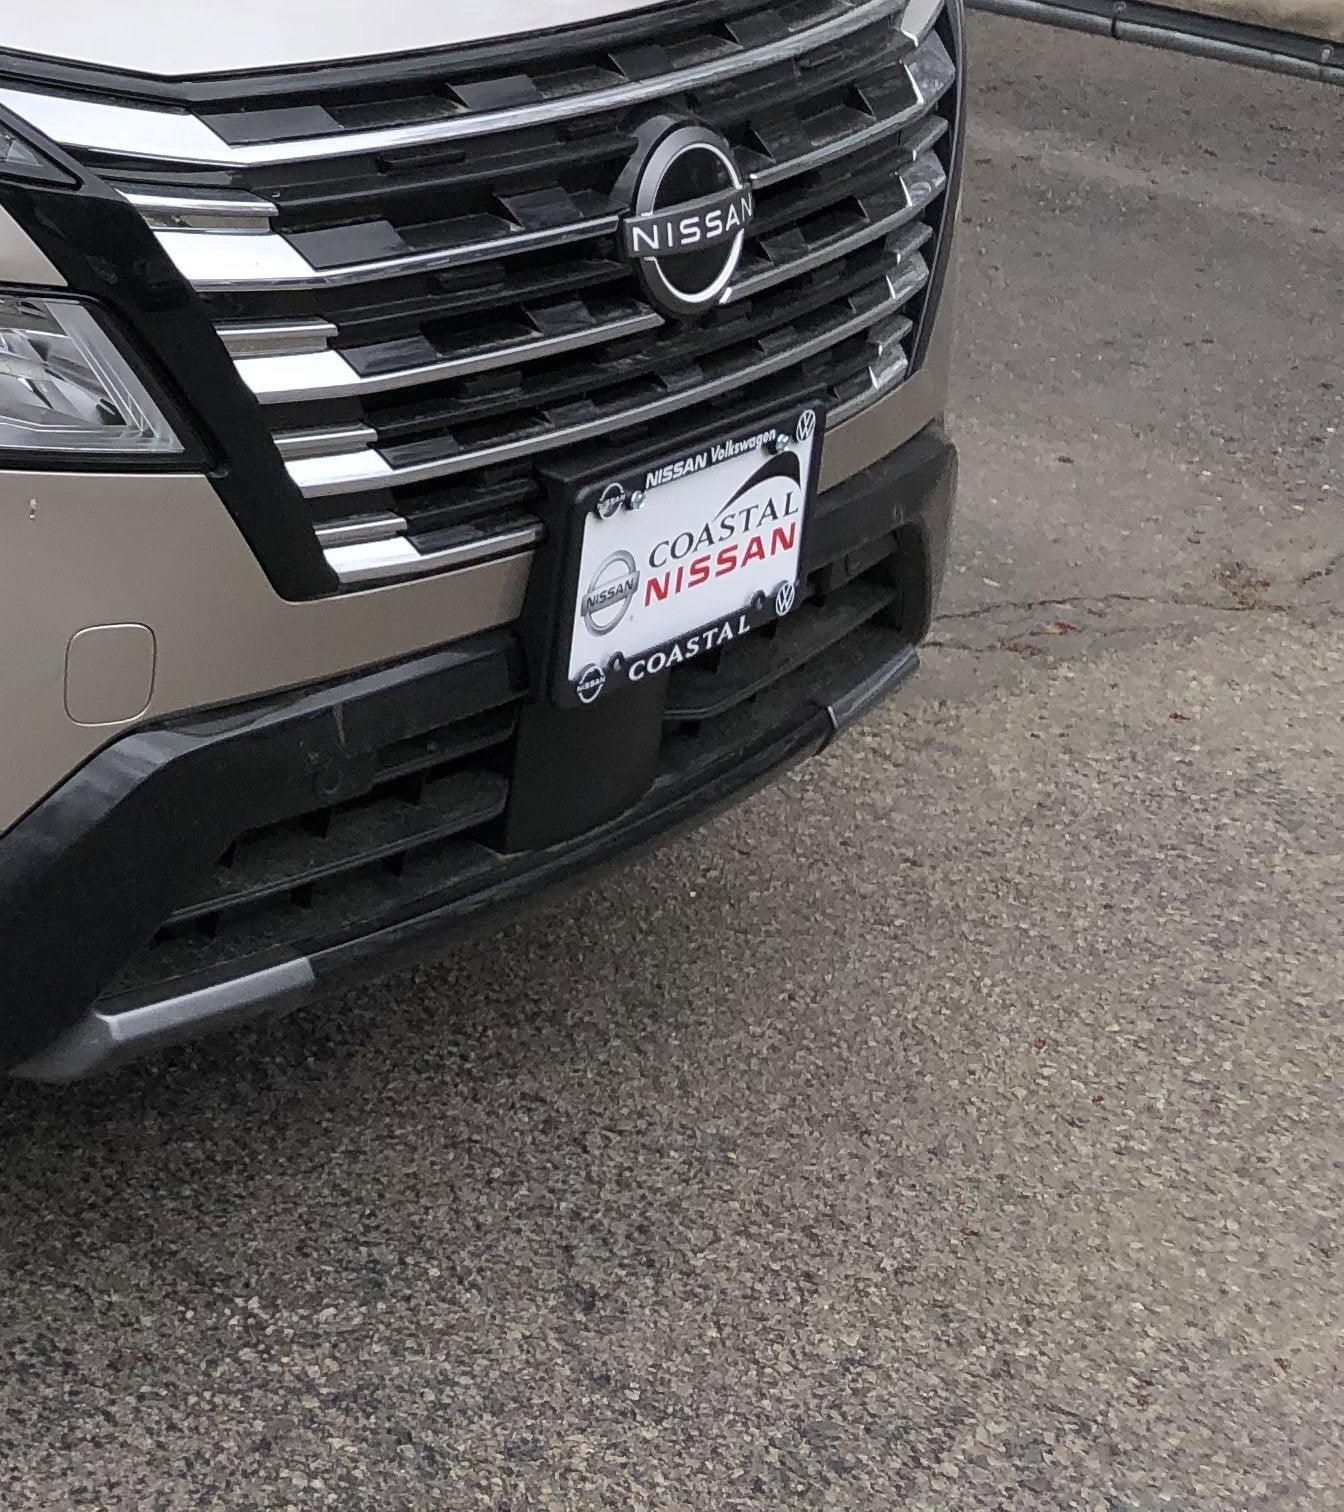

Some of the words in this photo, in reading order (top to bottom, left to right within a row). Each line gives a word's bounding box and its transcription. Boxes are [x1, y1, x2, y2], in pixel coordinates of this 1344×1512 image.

[632, 192, 753, 251] NISSAN
[645, 452, 707, 489] NISSAN
[711, 428, 776, 464] Volkswagen
[648, 491, 799, 569] COASTAL
[586, 576, 635, 609] NISSAN
[644, 521, 796, 607] NISSAN
[628, 614, 751, 681] COASTAL
